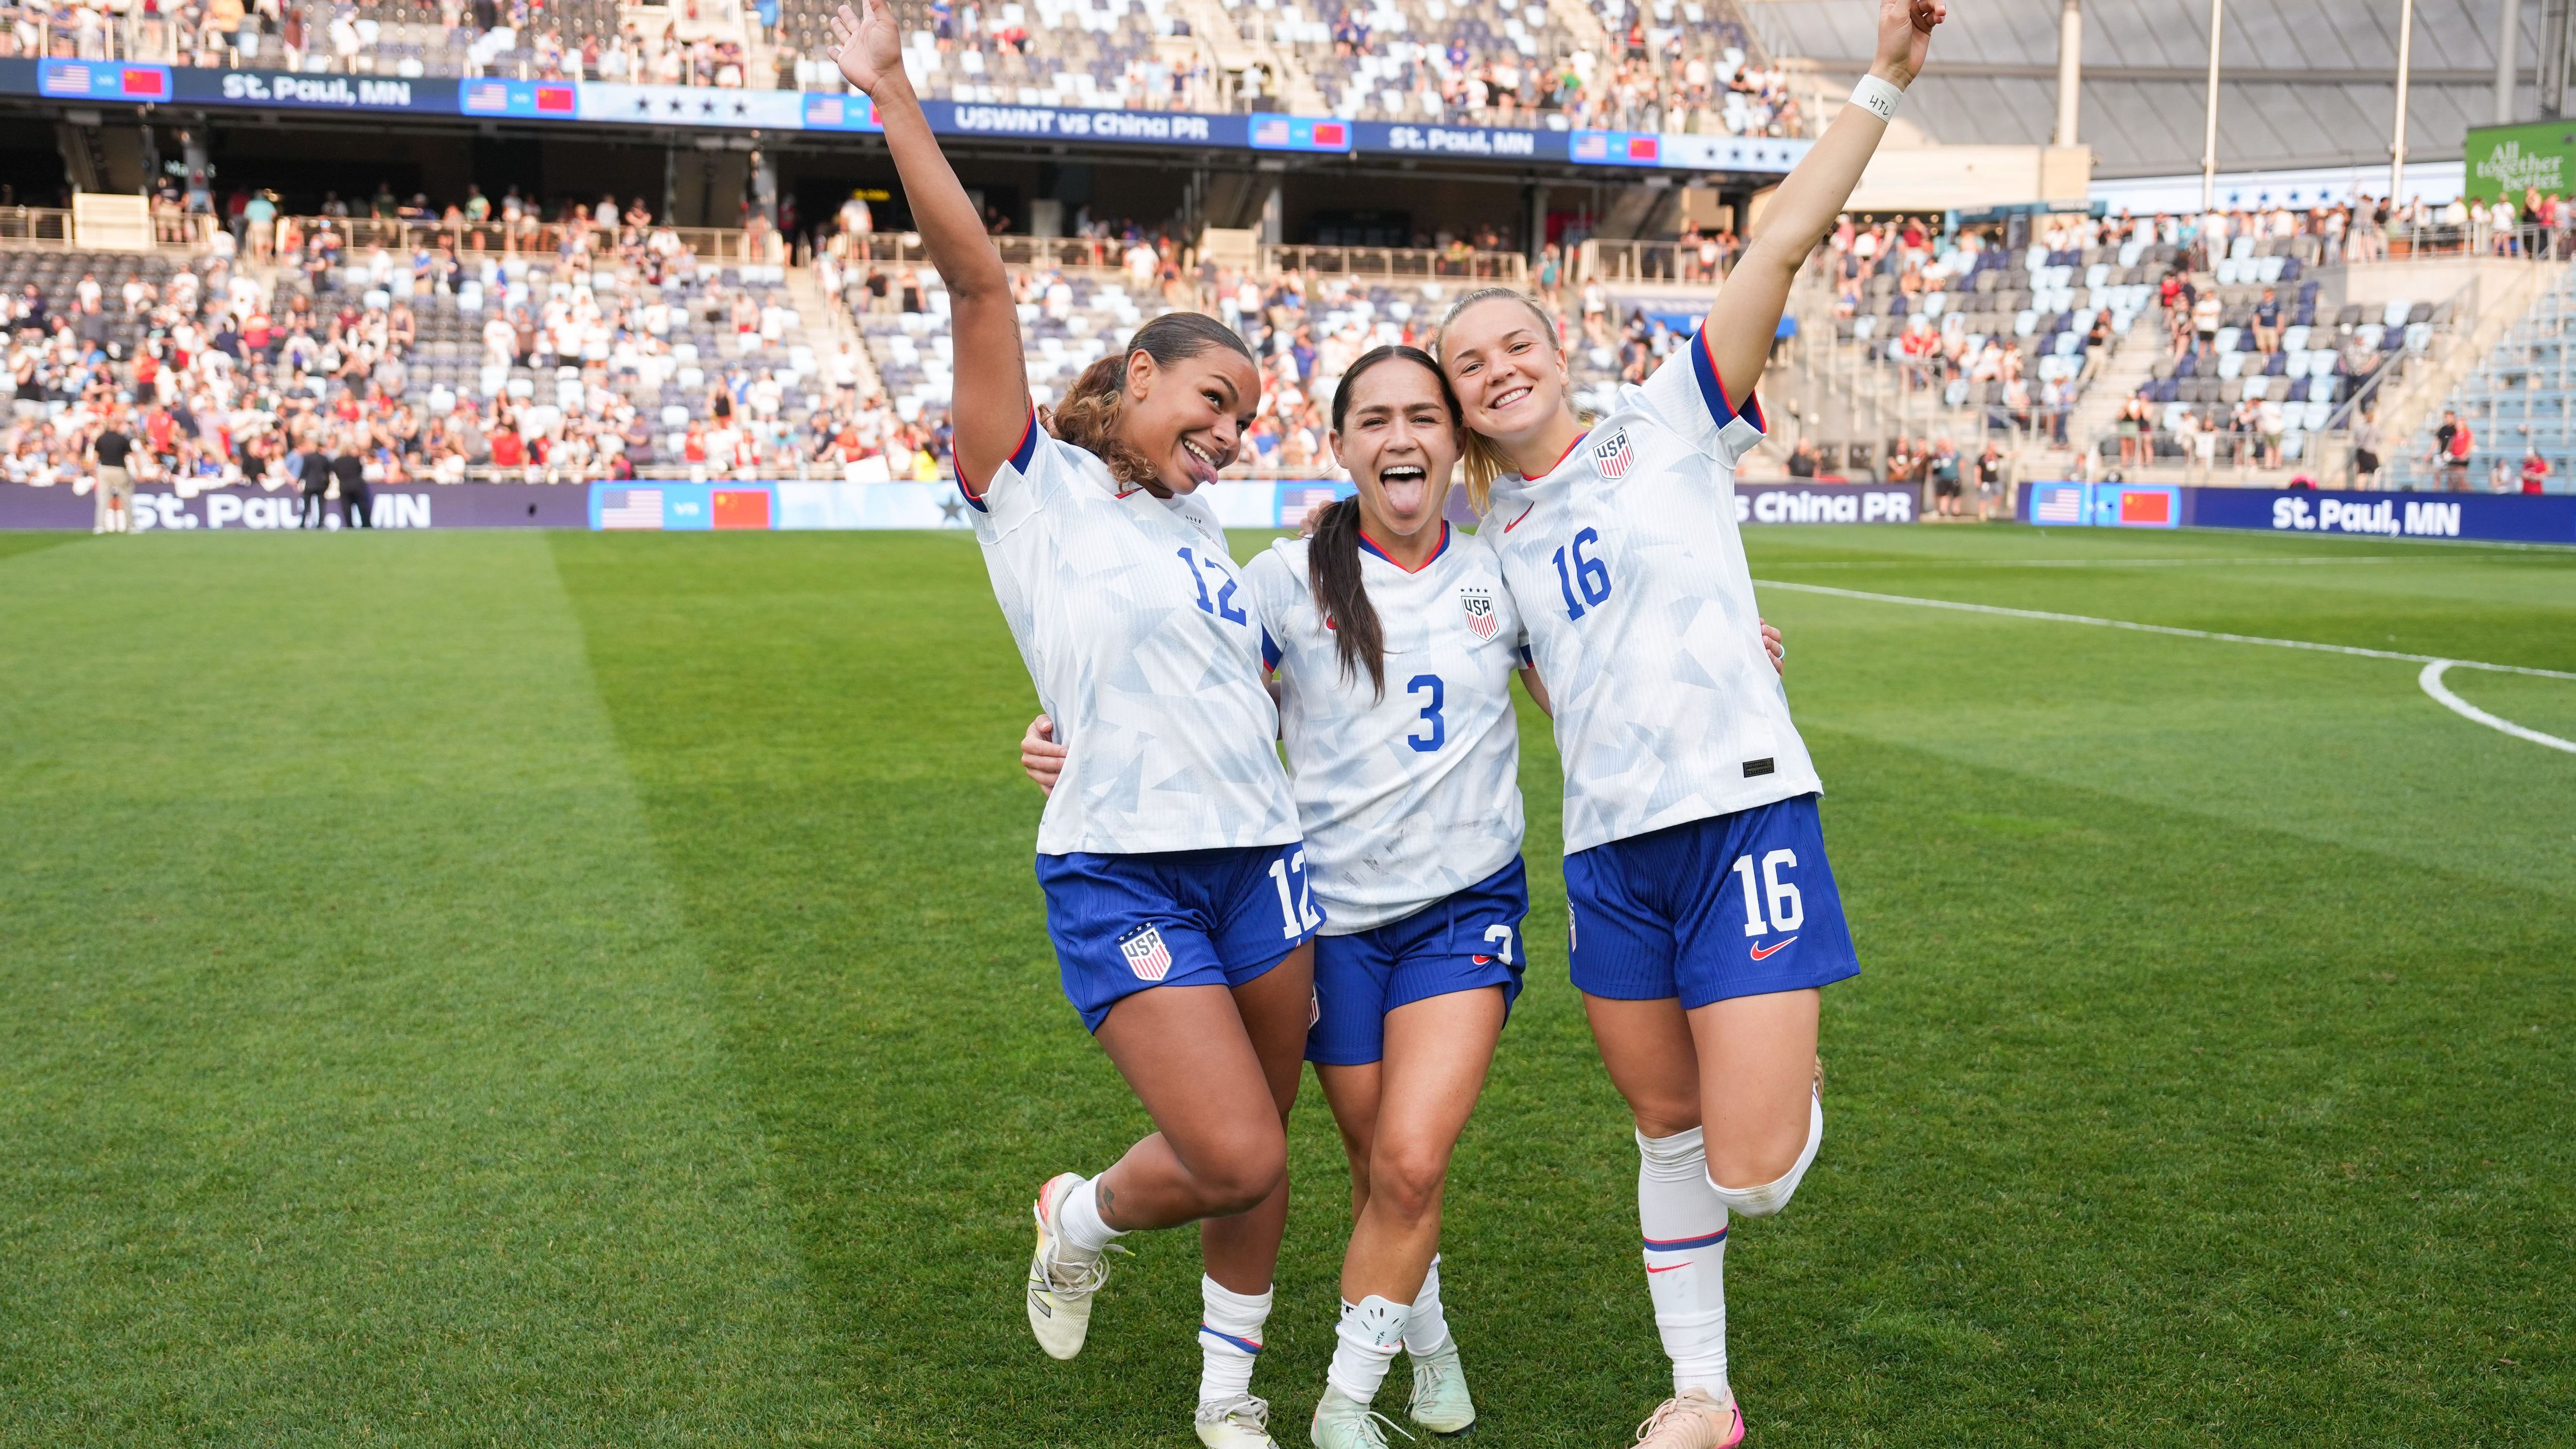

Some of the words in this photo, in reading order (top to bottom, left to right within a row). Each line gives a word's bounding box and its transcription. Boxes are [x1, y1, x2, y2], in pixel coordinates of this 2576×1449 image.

[222, 73, 271, 99] St.
[273, 76, 357, 107] Paul,
[358, 79, 411, 106] MN
[954, 106, 1055, 133] USWNT
[1057, 113, 1090, 134] vs
[1092, 112, 1170, 138] China
[1171, 115, 1209, 140] PR
[1389, 126, 1426, 150] St.
[1428, 128, 1491, 154] Paul,
[1493, 131, 1534, 154] MN
[2477, 152, 2564, 181] together
[2490, 141, 2519, 164] All
[1597, 434, 1626, 458] USA
[131, 492, 199, 529] St.
[1754, 491, 1858, 523] China
[1863, 492, 1912, 523] PR
[2272, 497, 2317, 530] St.
[2319, 499, 2401, 538] Paul,
[2404, 501, 2461, 536] MN
[1177, 547, 1246, 627] 12
[1553, 526, 1612, 621] 16
[1464, 599, 1490, 616] USA
[1407, 674, 1445, 752] 3
[1268, 849, 1321, 939] 12
[1733, 848, 1804, 937] 16
[1124, 931, 1158, 957] USA
